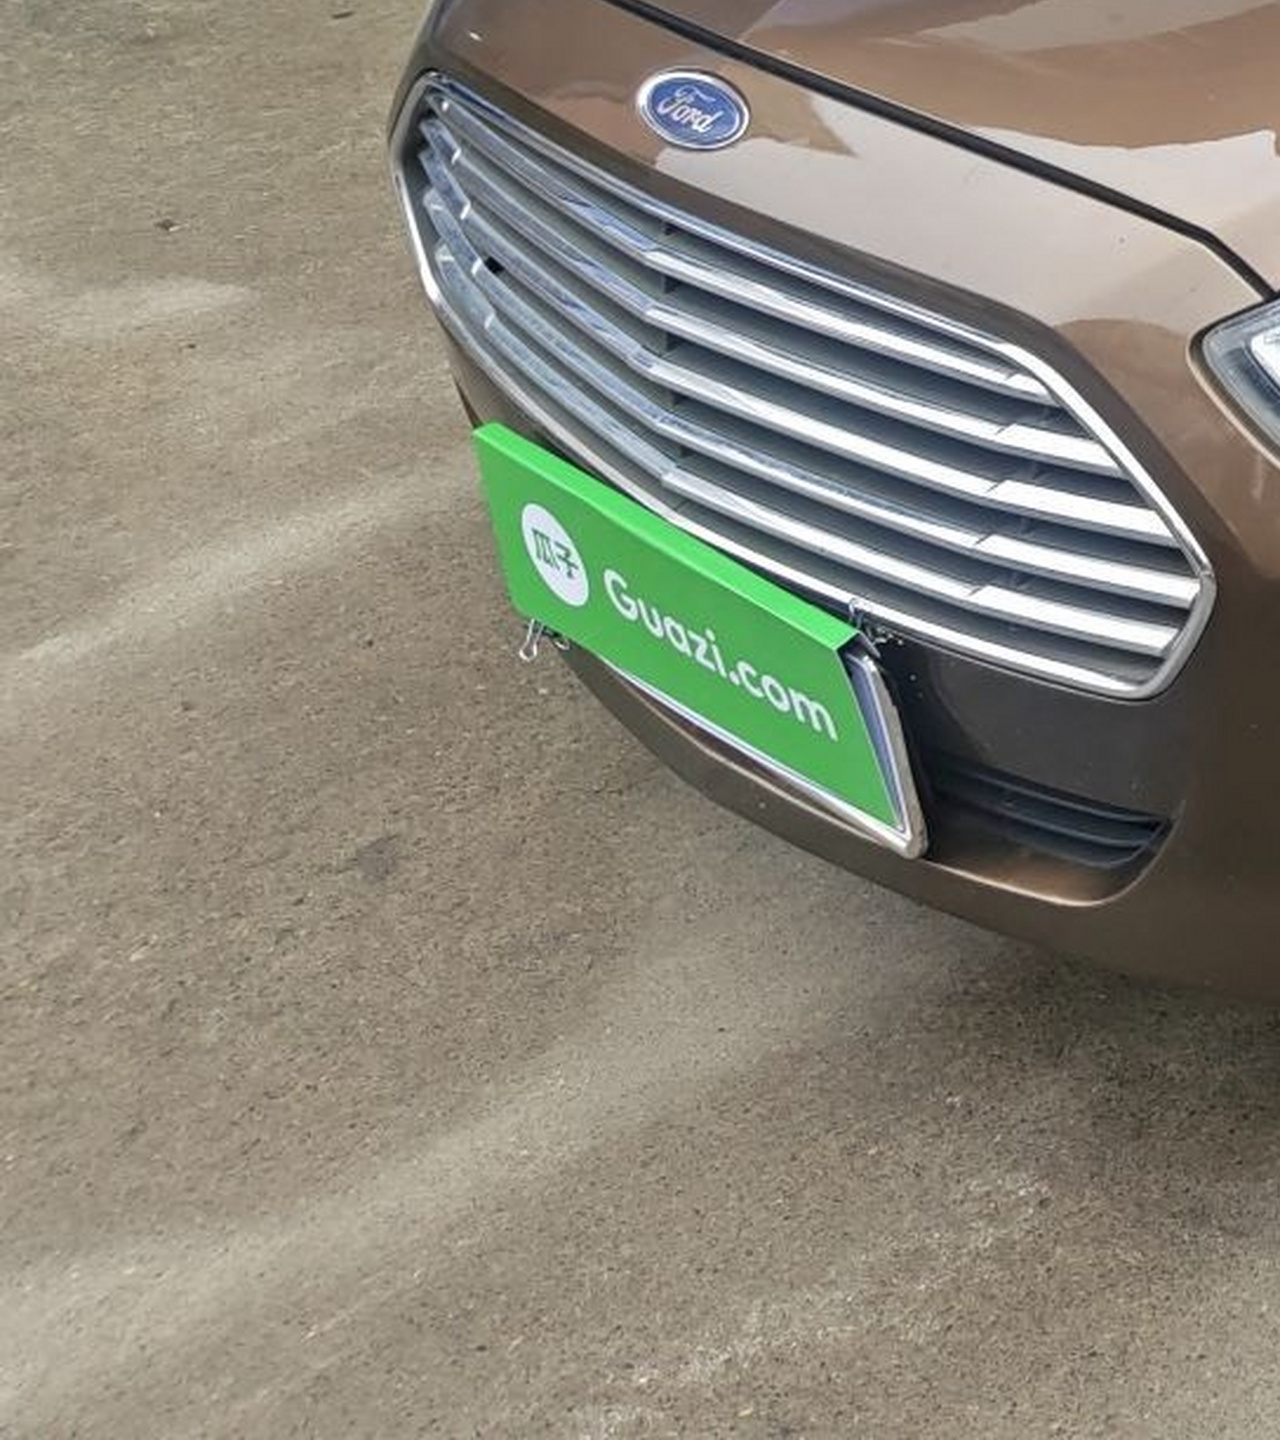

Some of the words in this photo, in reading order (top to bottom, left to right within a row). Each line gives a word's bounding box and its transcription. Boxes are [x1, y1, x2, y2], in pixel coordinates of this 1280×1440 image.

[656, 83, 725, 134] Ford
[531, 527, 580, 580] 瓜子
[603, 568, 839, 743] Guazi.com
